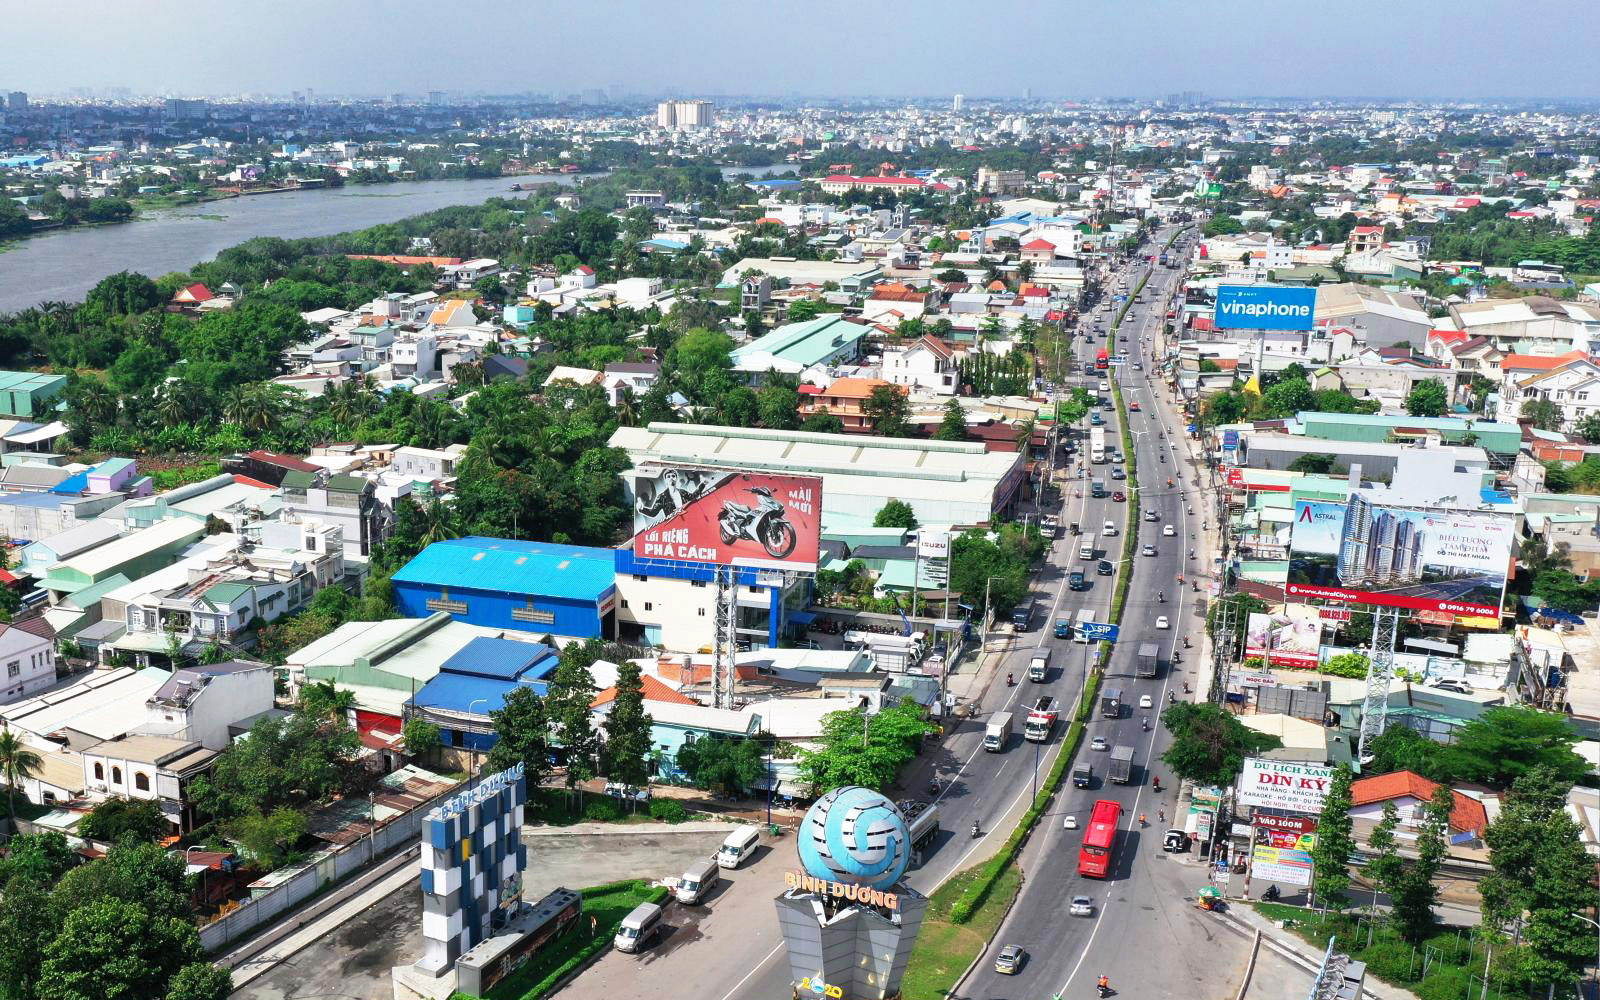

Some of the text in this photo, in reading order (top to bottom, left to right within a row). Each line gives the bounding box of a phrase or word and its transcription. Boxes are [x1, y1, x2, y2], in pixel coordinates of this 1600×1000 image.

[1221, 299, 1310, 318] vinaphone
[1314, 513, 1336, 521] ASTRAL
[662, 528, 689, 545] RIÊNG
[921, 541, 946, 549] ISUZU
[644, 543, 717, 561] PHÁ CÁCH
[1447, 604, 1465, 612] 0916
[1253, 762, 1270, 770] DU
[1258, 772, 1329, 791] DÌN KÝ
[1243, 791, 1272, 800] KARAOKE
[1259, 816, 1303, 829] VÀO 100M
[784, 870, 897, 910] BÌNH DƯƠNG
